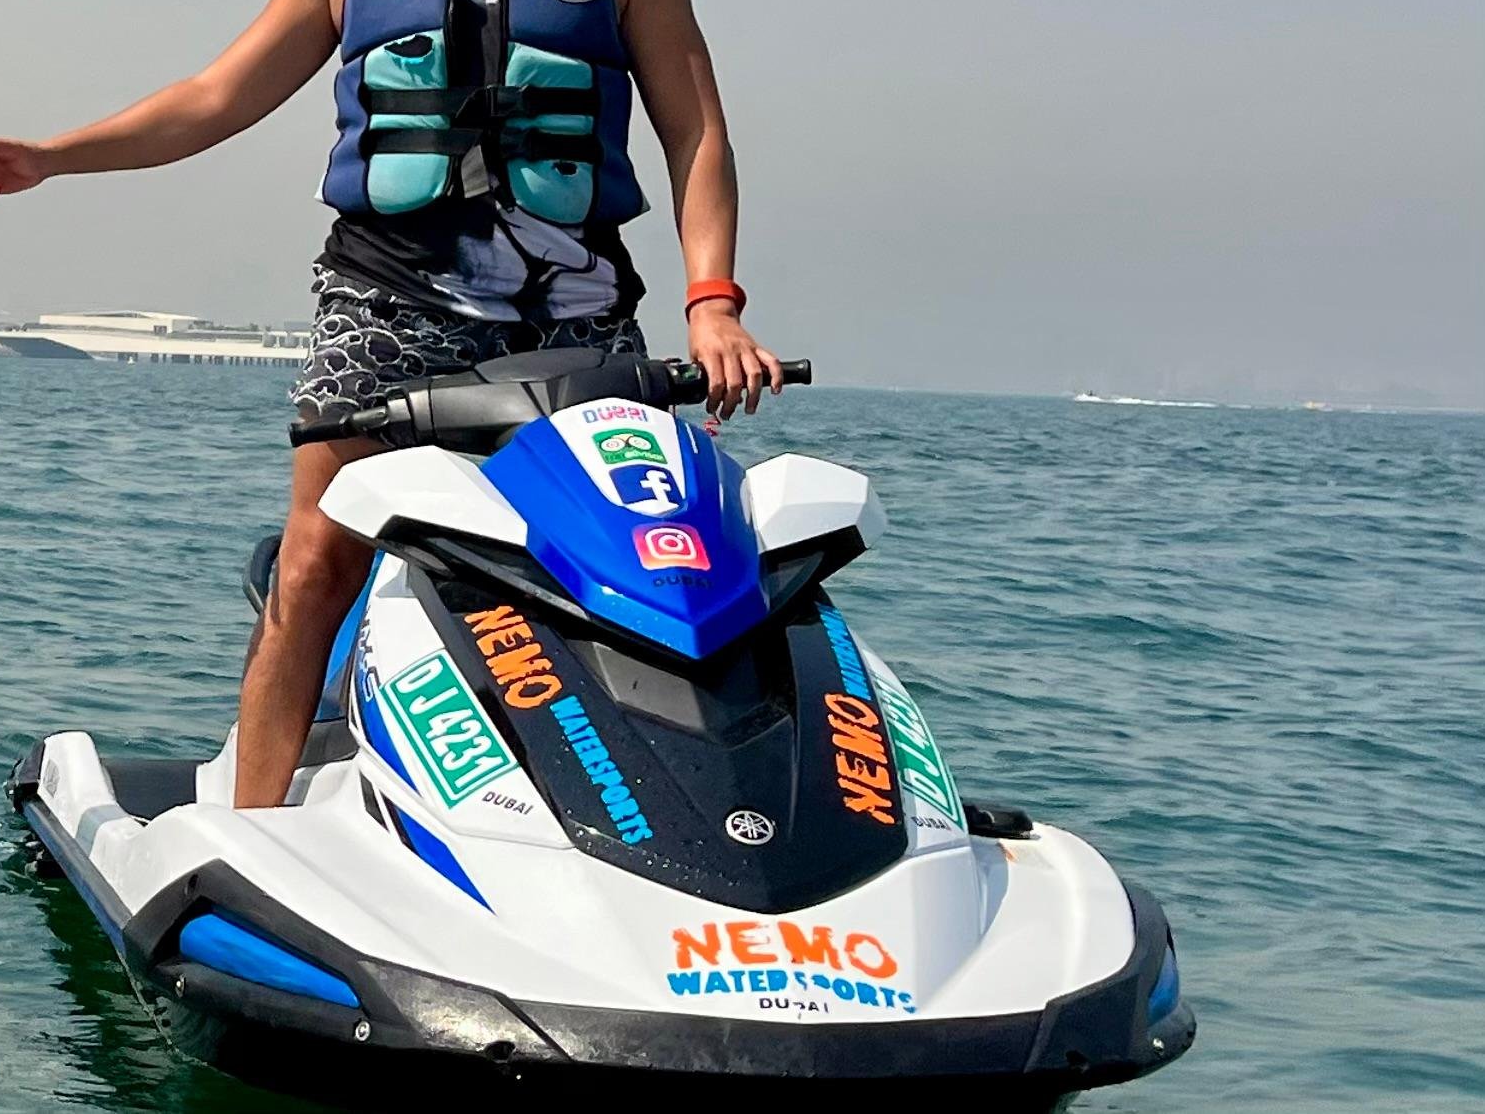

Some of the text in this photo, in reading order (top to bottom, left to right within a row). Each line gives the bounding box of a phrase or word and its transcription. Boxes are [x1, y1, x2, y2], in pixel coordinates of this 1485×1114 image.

[464, 605, 653, 845] NEMO WATERSPORTS
[824, 693, 895, 824] NEMO
[482, 790, 534, 815] DUBAI
[912, 815, 951, 832] DUBAI
[672, 920, 898, 979] NEMO
